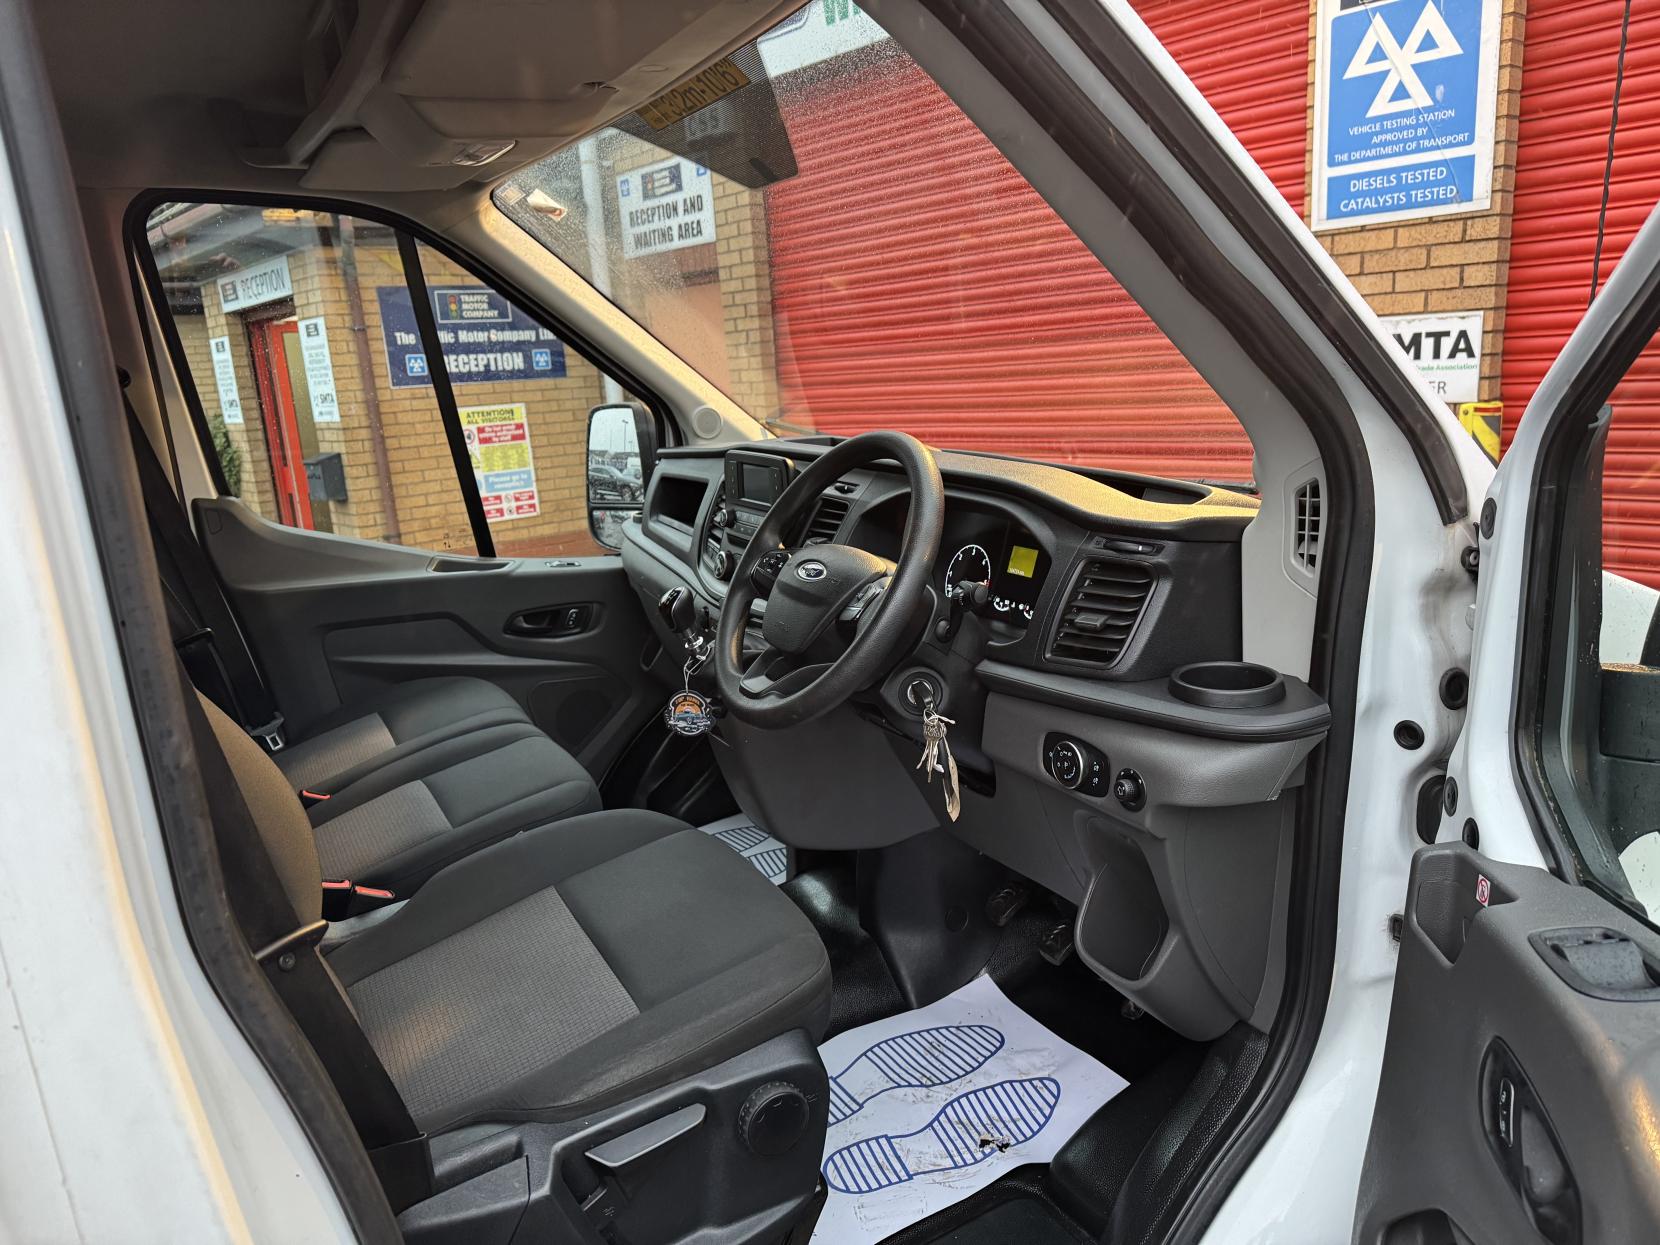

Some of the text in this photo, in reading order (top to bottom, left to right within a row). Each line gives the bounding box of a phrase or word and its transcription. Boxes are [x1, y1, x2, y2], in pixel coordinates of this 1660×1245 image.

[1348, 108, 1455, 136] VEHICLE TESTING STATION
[1371, 127, 1428, 144] APPROVED BY
[1334, 132, 1469, 163] THE DEPARTMENT OF TRANSPORT
[1350, 166, 1447, 193] DIESELS TESTED
[629, 194, 704, 229] RECEPTION AND
[1340, 186, 1457, 212] CATALYSTS TESTED
[633, 219, 703, 250] WAITING AREA
[240, 267, 286, 299] RECEPTION
[463, 310, 499, 319] COMPANY
[394, 331, 417, 346] The
[457, 330, 489, 343] Motor
[489, 329, 536, 343] Company
